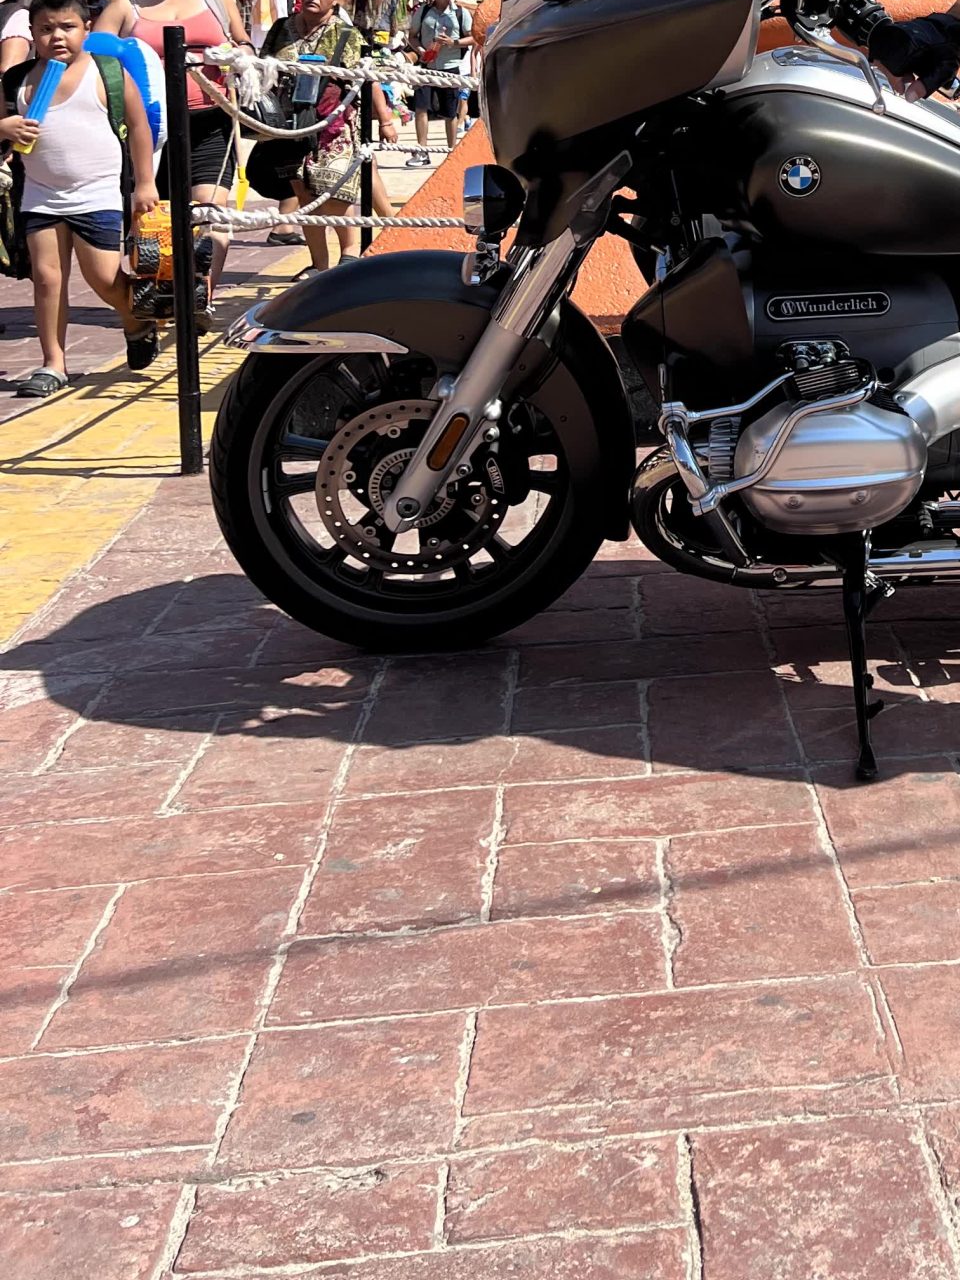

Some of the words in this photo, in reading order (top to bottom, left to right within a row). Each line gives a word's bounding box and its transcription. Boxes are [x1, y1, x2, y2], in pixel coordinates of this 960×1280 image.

[784, 158, 817, 171] BMW
[795, 298, 877, 313] Wunderlich
[488, 465, 503, 488] BMW
